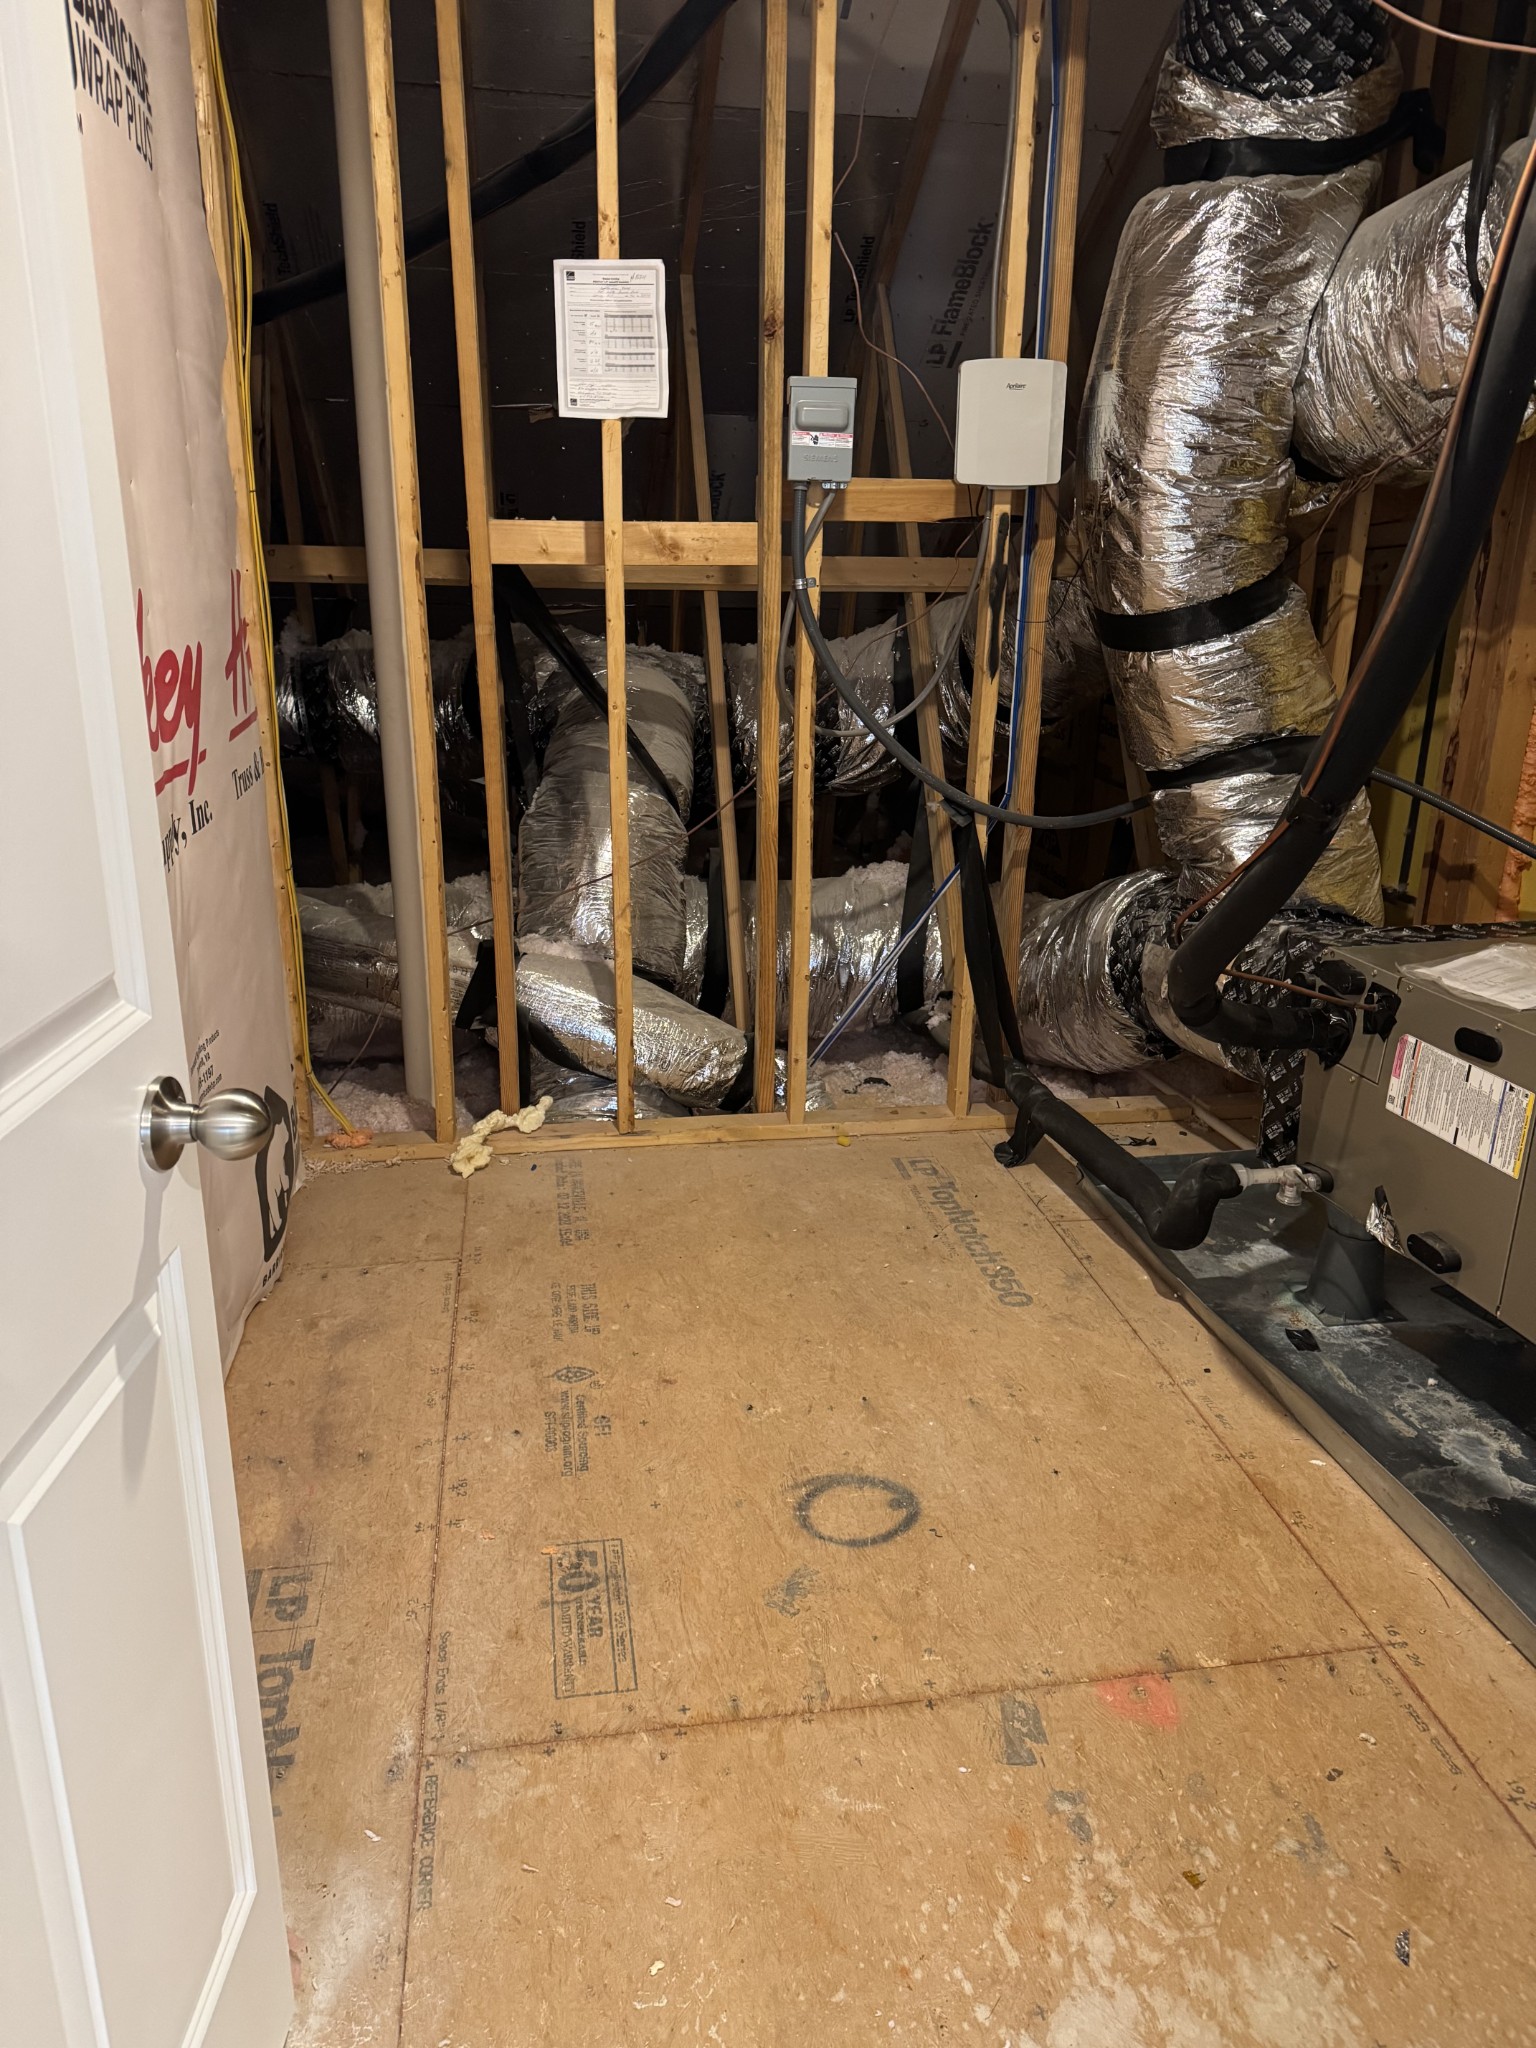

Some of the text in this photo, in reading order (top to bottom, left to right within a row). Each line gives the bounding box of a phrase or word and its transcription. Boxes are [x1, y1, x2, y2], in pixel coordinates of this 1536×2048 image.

[75, 21, 153, 172] WRAP PLUS
[232, 762, 253, 801] Truss
[189, 800, 213, 834] Inc.
[580, 1283, 597, 1300] THIS
[576, 1394, 590, 1472] Certified Sourcing
[557, 1550, 601, 1593] 50
[266, 1571, 313, 1624] LP
[588, 1595, 604, 1638] YEAR
